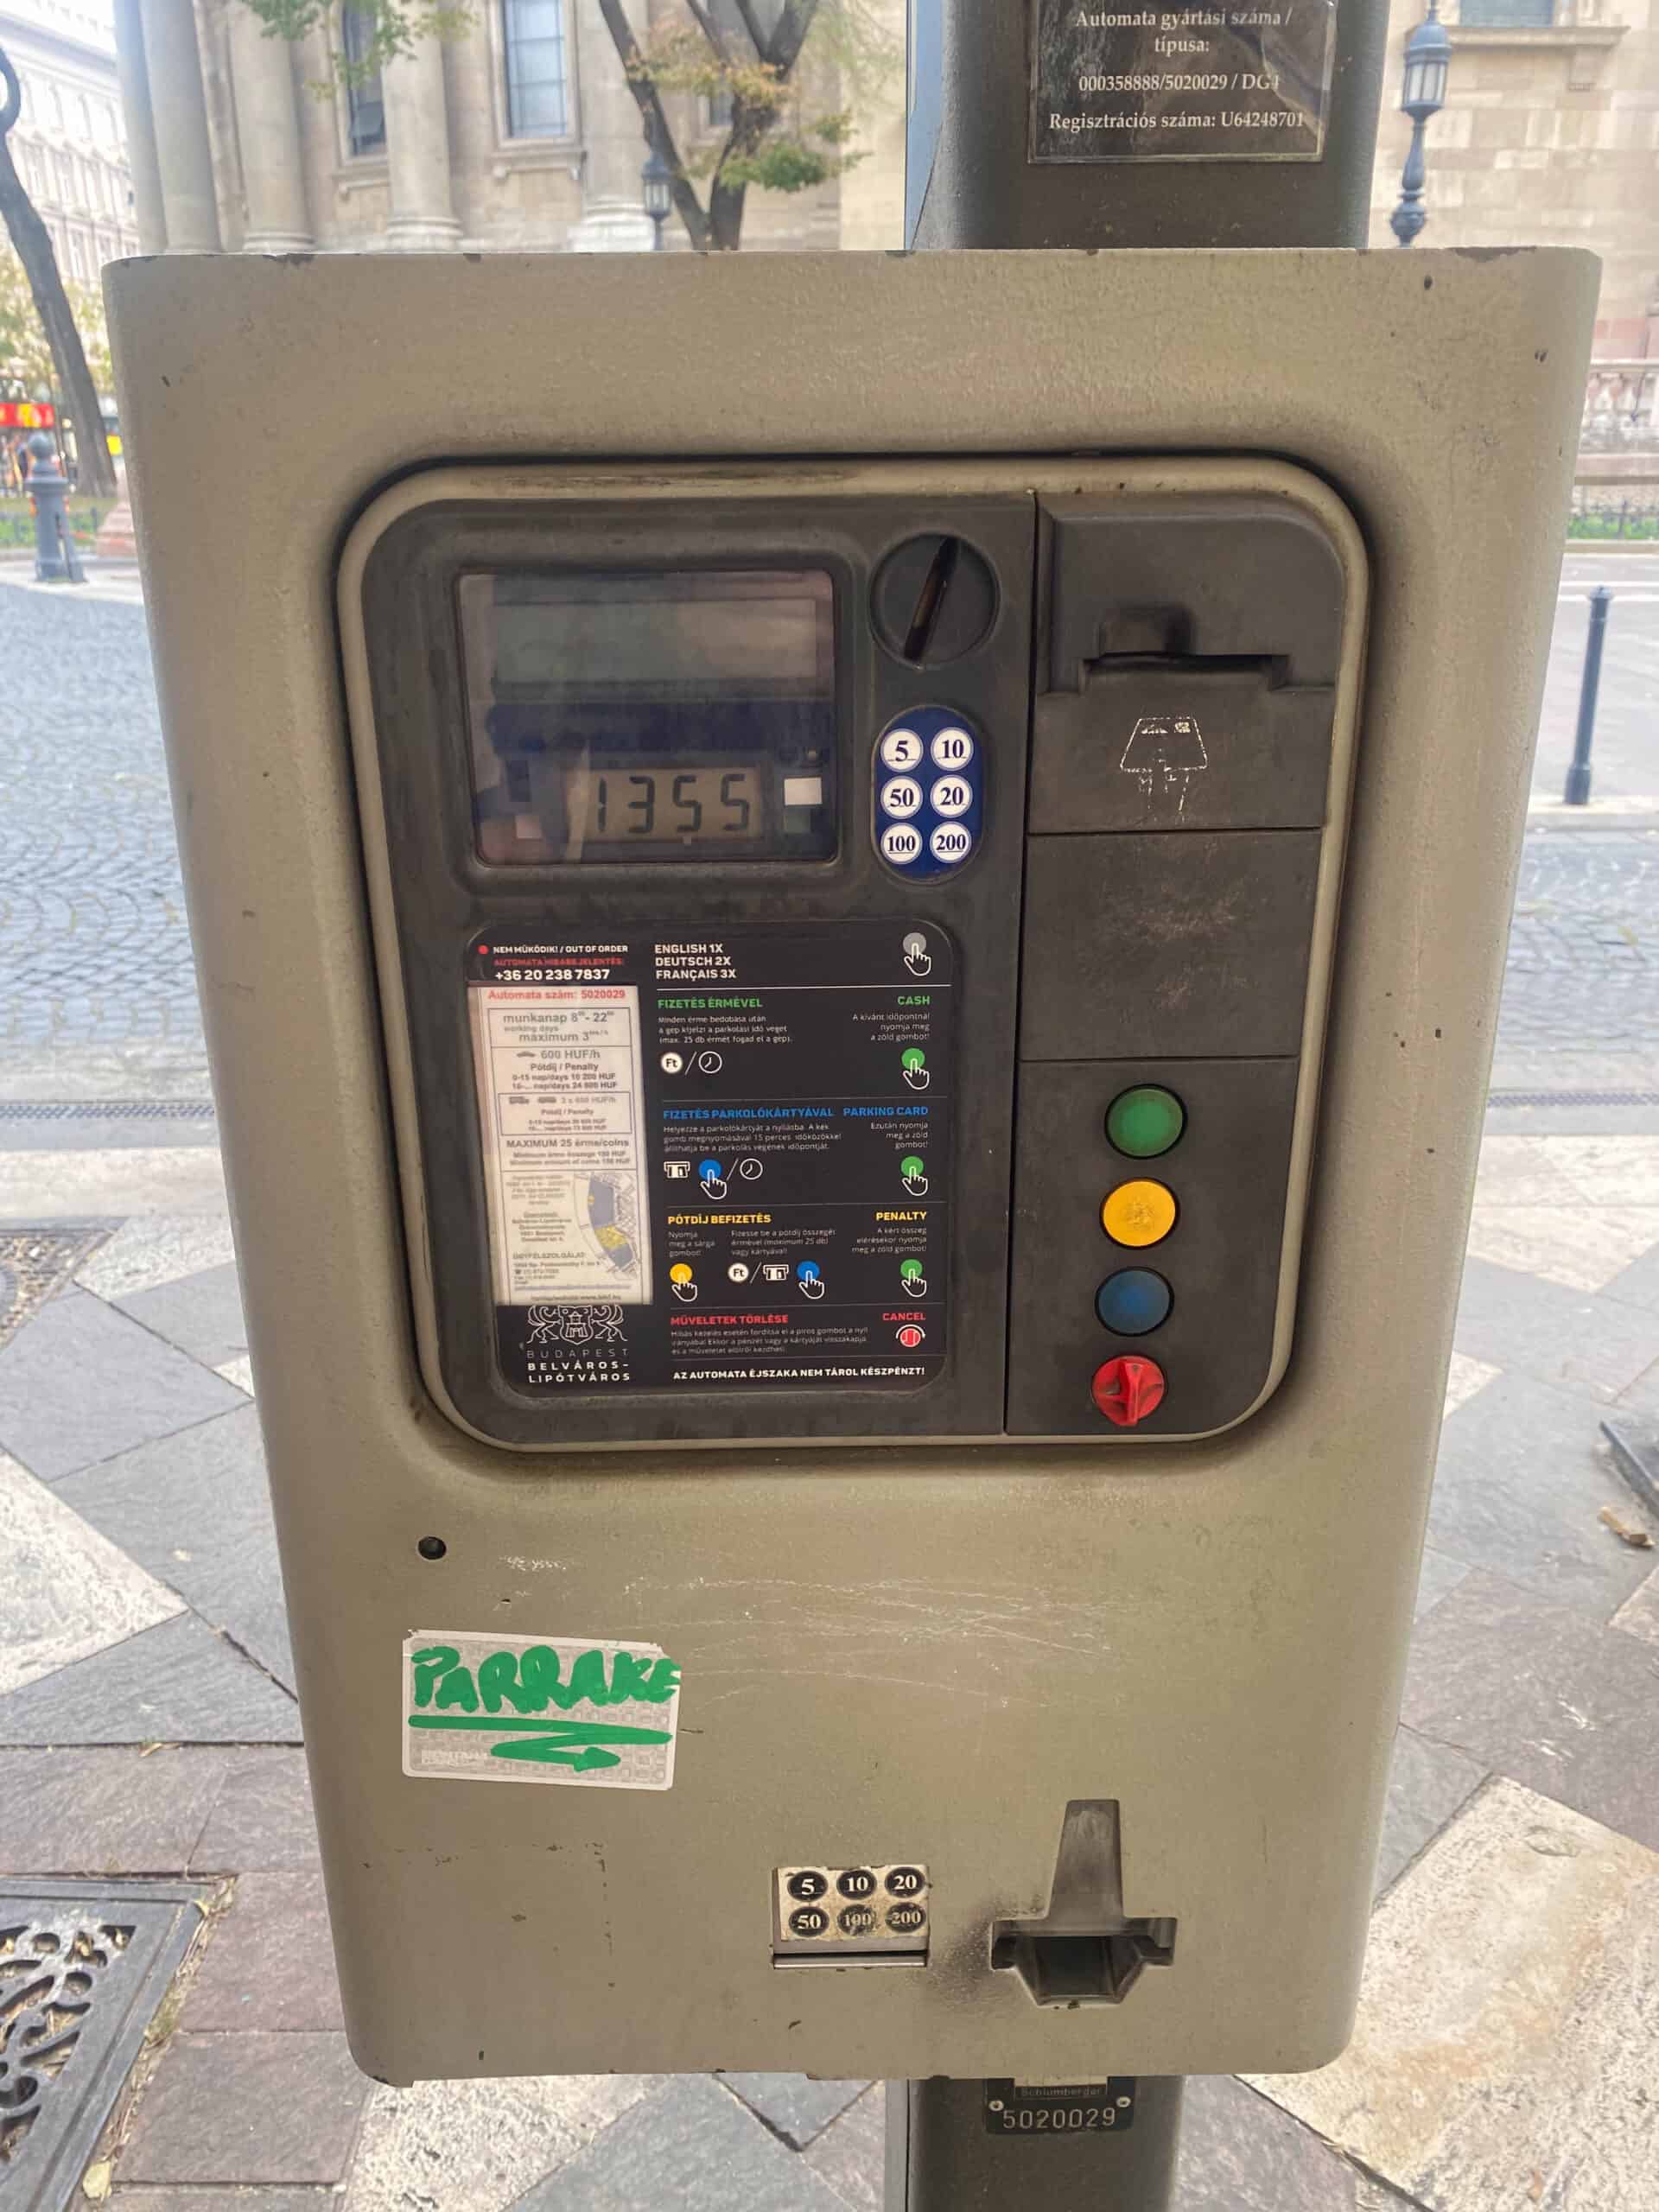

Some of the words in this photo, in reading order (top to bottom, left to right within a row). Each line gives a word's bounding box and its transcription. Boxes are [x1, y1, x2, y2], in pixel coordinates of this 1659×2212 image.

[1076, 10, 1156, 27] Automata
[1160, 9, 1226, 30] gyártási
[1230, 8, 1281, 25] száma
[1154, 36, 1210, 56] típusa:
[1079, 74, 1228, 92] 000358888/5020029
[1050, 111, 1157, 133] Regisztrációs
[1160, 111, 1216, 129] száma:
[1221, 111, 1304, 128] U64248701
[895, 740, 909, 762] 5
[942, 739, 964, 759] 10
[890, 787, 914, 807] 50
[940, 786, 964, 806] 20
[598, 773, 751, 834] 1355
[887, 835, 916, 852] 100
[936, 834, 966, 851] 200
[493, 945, 513, 955] NEM
[565, 944, 583, 954] OUT
[585, 944, 596, 953] OF
[598, 944, 628, 953] ORDER
[654, 944, 707, 954] ENGLISH
[709, 944, 723, 953] 1X
[655, 957, 713, 967] DEUTSCH
[715, 956, 732, 966] 2X
[495, 969, 522, 981] +36
[524, 969, 543, 981] 20
[545, 969, 573, 981] 238
[575, 969, 610, 980] 7837
[656, 969, 718, 982] FRANÇAIS
[720, 969, 737, 979] 3X
[488, 989, 542, 1000] Automata
[545, 989, 576, 1000] szám:
[581, 988, 626, 999] 5020029
[658, 997, 706, 1009] FIZETÉS
[708, 996, 763, 1008] ÉRMÉVEL
[897, 995, 931, 1006] CASH
[503, 1013, 568, 1025] munkanap
[880, 1023, 910, 1032] nyomja
[518, 1032, 579, 1042] maximum
[733, 1035, 754, 1044] fogad
[541, 1050, 561, 1059] 600
[564, 1049, 601, 1059] HUF/h
[564, 1063, 599, 1072] Penalty
[665, 1058, 678, 1068] Ft
[664, 1109, 710, 1120] FIZETÉS
[712, 1106, 835, 1119] PARKOLÓKÁRTYÁVAL
[843, 1107, 894, 1117] PARKING
[896, 1106, 929, 1116] CARD
[506, 1140, 557, 1148] MAXIMUM
[560, 1139, 573, 1147] 25
[668, 1213, 709, 1225] PÓTDÍJ
[710, 1211, 772, 1224] BEFIZETÉS
[876, 1211, 927, 1221] PENALTY
[733, 1268, 745, 1277] Ft
[739, 1313, 789, 1325] TÖRLÉSE
[882, 1313, 926, 1321] CANCEL
[526, 1348, 629, 1359] BUDAPEST
[528, 1359, 629, 1371] BELVÁROS-
[529, 1371, 630, 1383] LIPÓTVÁROS
[673, 1371, 687, 1380] AZ
[690, 1370, 747, 1380] AUTOMATA
[749, 1369, 798, 1378] ÉJSZAKA
[800, 1368, 823, 1377] NEM
[824, 1367, 859, 1376] TÁROL
[860, 1366, 925, 1376] KÉSZPÉNZT!
[801, 1878, 815, 1896] 5
[846, 1876, 869, 1892] 10
[894, 1874, 918, 1891] 20
[798, 1914, 822, 1930] 50
[843, 1913, 873, 1928] 100
[891, 1910, 922, 1925] 200
[1002, 2107, 1116, 2130] 5020029
